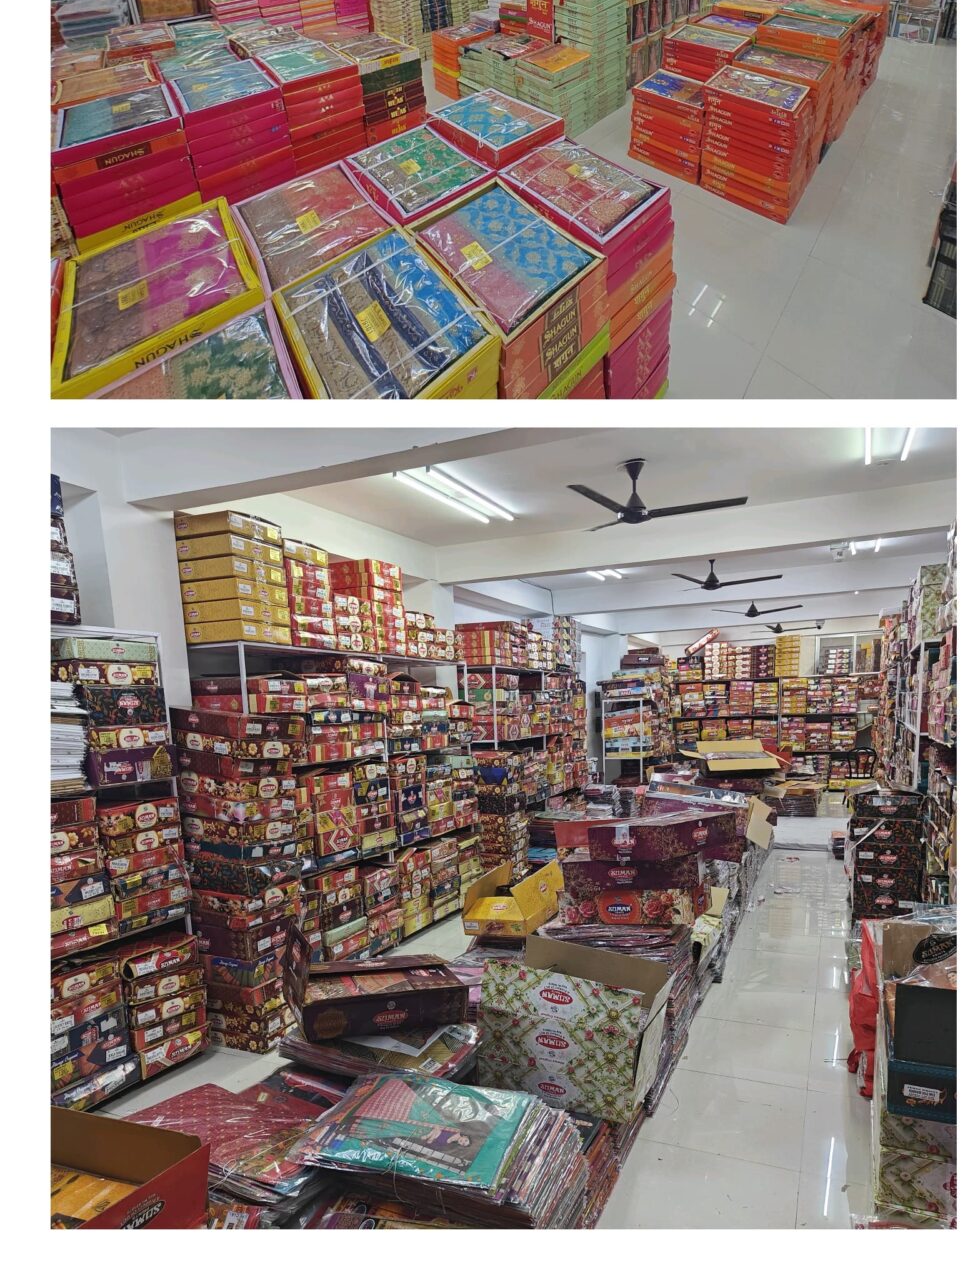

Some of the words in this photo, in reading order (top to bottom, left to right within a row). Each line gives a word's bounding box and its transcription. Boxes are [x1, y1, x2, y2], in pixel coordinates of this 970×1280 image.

[104, 147, 145, 168] SHAGUN
[543, 308, 577, 348] SHAGUN
[133, 327, 204, 370] SHAGUN
[544, 325, 577, 366] SHAGUN
[553, 343, 576, 369] शगुन
[160, 957, 181, 968] SUMAN
[541, 991, 571, 1004] SUMAN
[376, 1013, 406, 1022] SUMAN
[537, 1037, 567, 1049] SUMAN
[171, 1044, 192, 1057] SUMAN
[539, 1083, 566, 1094] SUMAN
